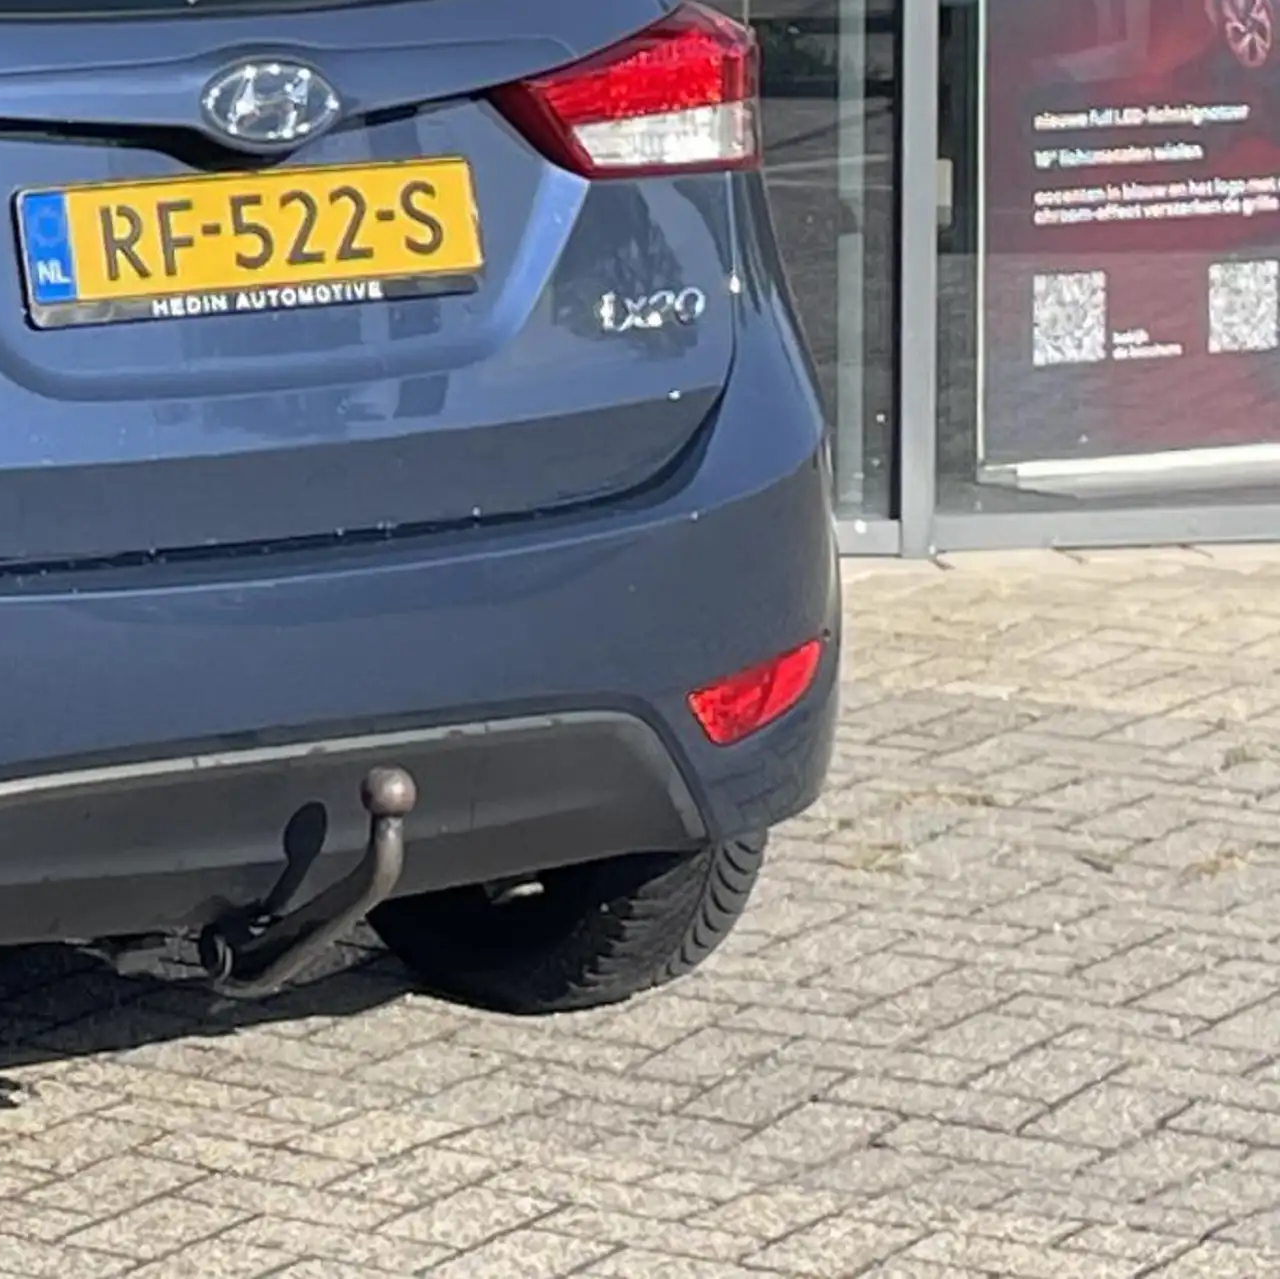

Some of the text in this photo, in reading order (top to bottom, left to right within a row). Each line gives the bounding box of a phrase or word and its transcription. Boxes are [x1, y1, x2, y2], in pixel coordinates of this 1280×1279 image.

[99, 180, 444, 282] RF-522-S
[38, 259, 71, 285] NL
[152, 280, 384, 318] HEDIN AUTOMOTIVE
